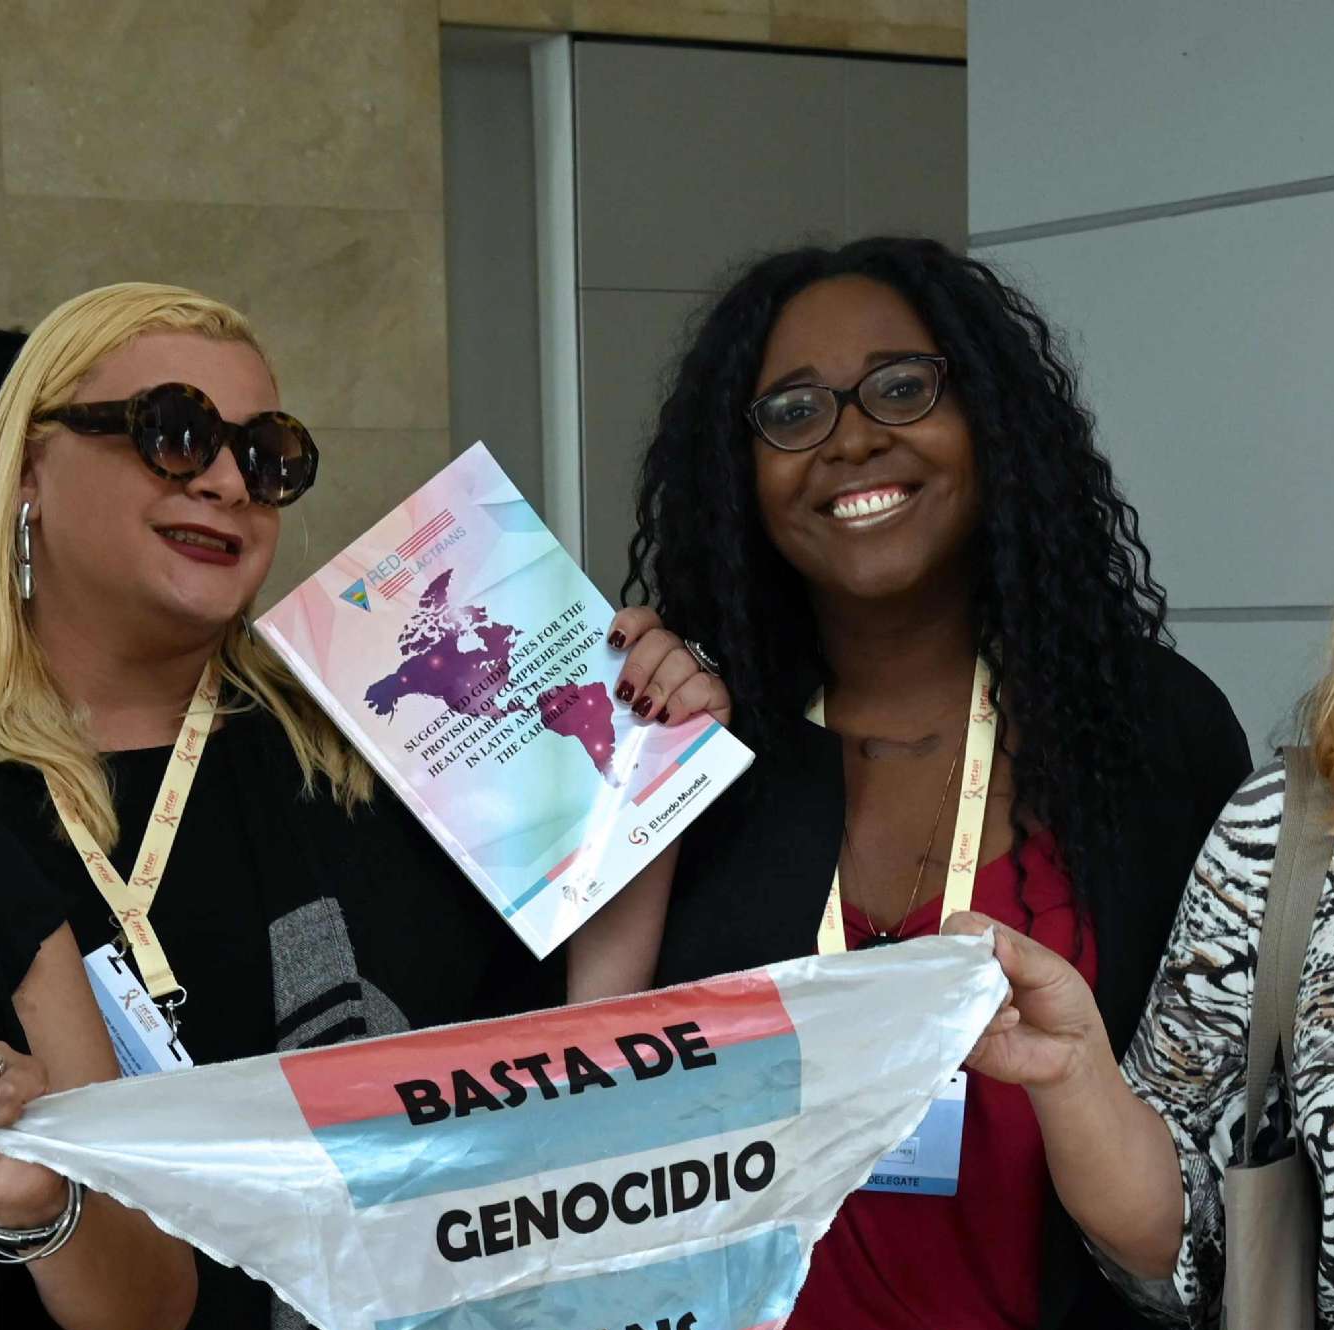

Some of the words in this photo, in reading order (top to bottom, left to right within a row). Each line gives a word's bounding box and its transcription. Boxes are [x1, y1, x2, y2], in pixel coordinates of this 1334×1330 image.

[367, 553, 401, 586] RED
[408, 525, 467, 576] LACTRANS
[403, 693, 472, 753] SUGGESTED
[469, 638, 539, 699] GUIDELINES
[536, 620, 561, 643] FOR
[559, 599, 586, 624] THE
[420, 708, 481, 760] PROVISION
[479, 695, 496, 712] OF
[495, 619, 588, 698] COMPREHENSIVE
[465, 752, 480, 768] IN
[479, 724, 515, 756] LATIN
[512, 683, 563, 728] AMERICA
[563, 662, 589, 686] AND
[499, 694, 524, 717] FOR
[522, 661, 562, 699] TRANS
[559, 627, 605, 667] WOMEN
[494, 740, 521, 766] THE
[519, 690, 581, 745] CARIBBEAN
[648, 819, 658, 829] El
[655, 798, 680, 823] Fondo
[677, 772, 707, 802] Mundial
[394, 1047, 617, 1125] BASTA
[615, 1021, 717, 1080] DE
[436, 1141, 776, 1263] GENOCIDIO
[868, 1175, 920, 1187] DELEGATE
